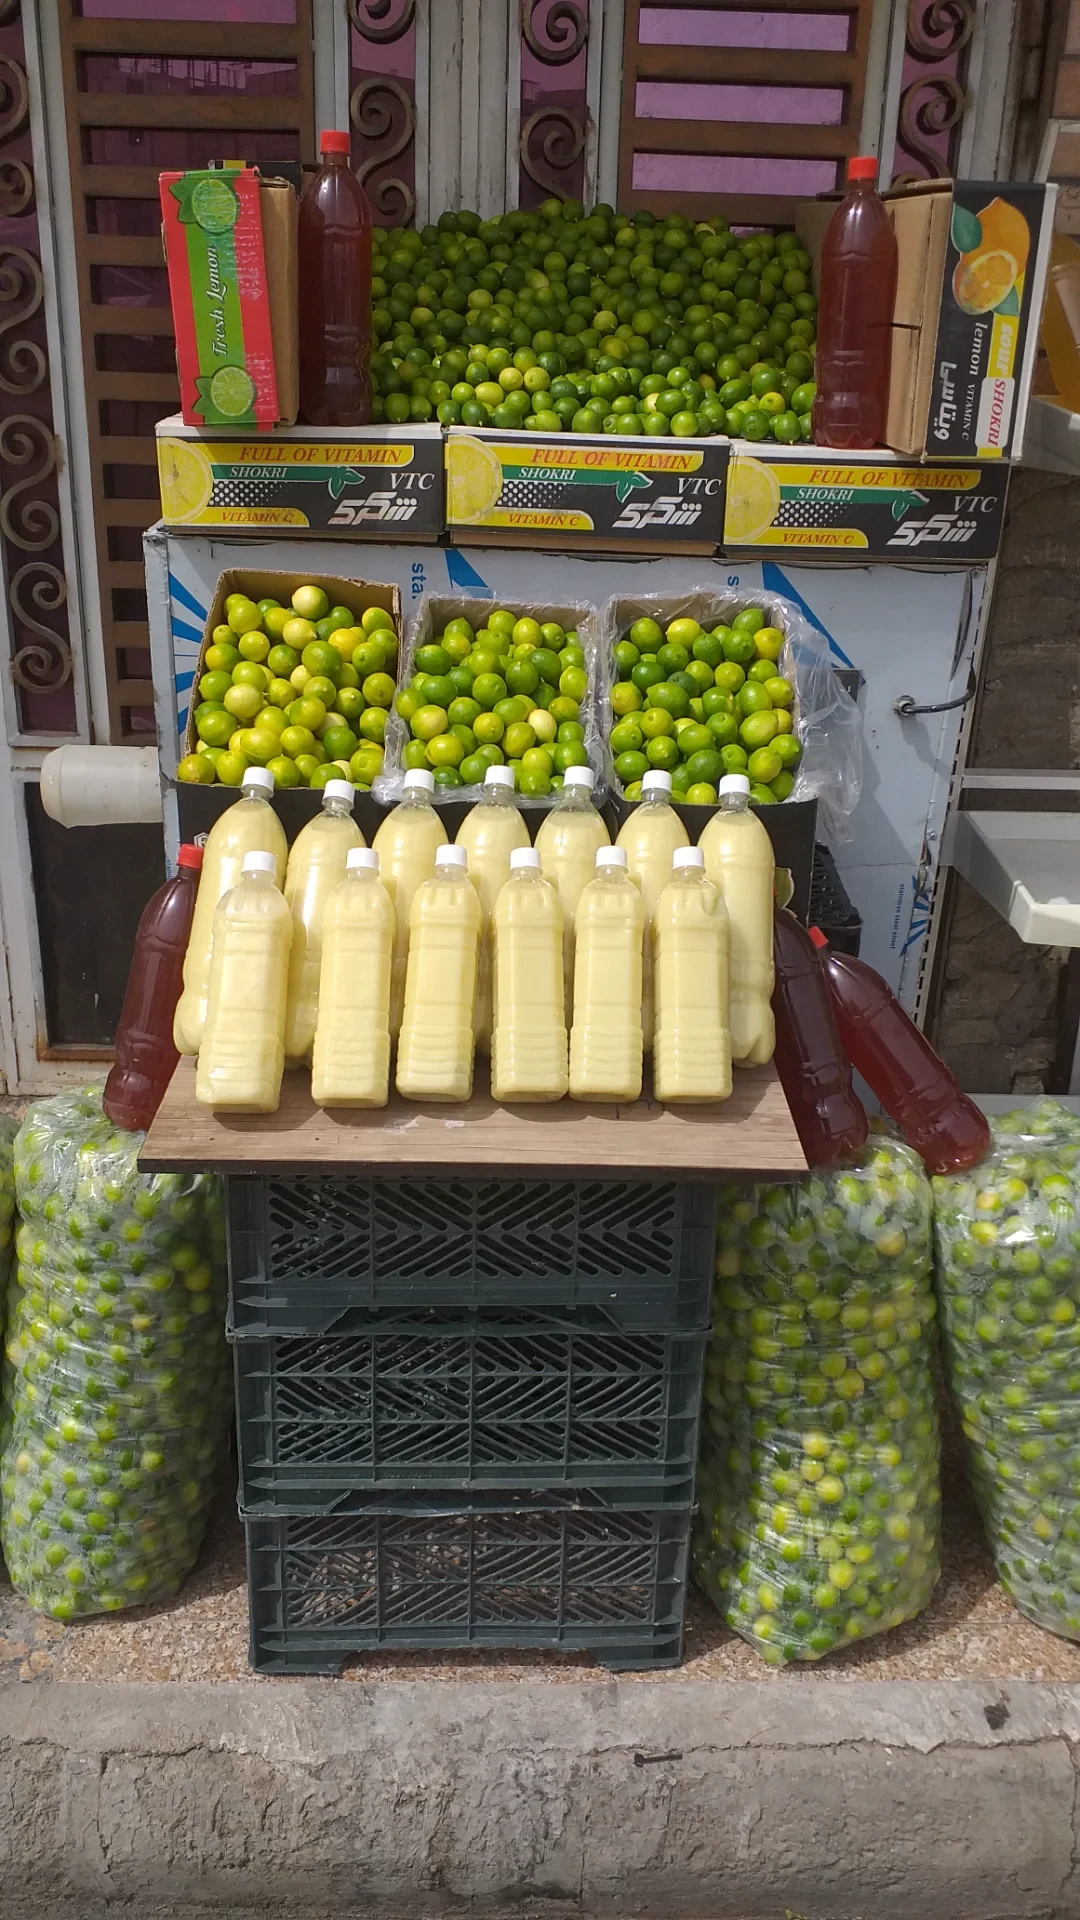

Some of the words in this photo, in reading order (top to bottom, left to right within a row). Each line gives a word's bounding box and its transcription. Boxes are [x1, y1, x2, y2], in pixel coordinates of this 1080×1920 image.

[206, 245, 227, 303] Lemon
[210, 307, 228, 357] Fresh
[968, 321, 989, 376] lemon
[996, 322, 1013, 376] sour
[963, 384, 976, 428] VITAMIN
[987, 378, 1007, 447] SHOKRI
[961, 432, 969, 440] C
[238, 446, 287, 462] FULL
[293, 448, 319, 462] OF
[324, 448, 402, 463] VITAMIN
[531, 449, 578, 465] FULL
[584, 451, 611, 466] OF
[615, 453, 693, 470] VITAMIN
[229, 466, 288, 478] SHOKRI
[390, 472, 435, 490] VTC
[519, 467, 577, 481] SHOKRI
[808, 470, 856, 485] FULL
[861, 471, 888, 486] OF
[892, 472, 970, 488] VITAMIN
[677, 477, 722, 496] VTC
[796, 487, 855, 501] SHOKRI
[953, 496, 998, 513] VTC
[221, 512, 279, 523] VITAMIN
[283, 512, 294, 524] C
[508, 513, 565, 526] VITAMIN
[570, 516, 580, 526] C
[782, 533, 839, 545] VITAMIN
[843, 535, 854, 545] C
